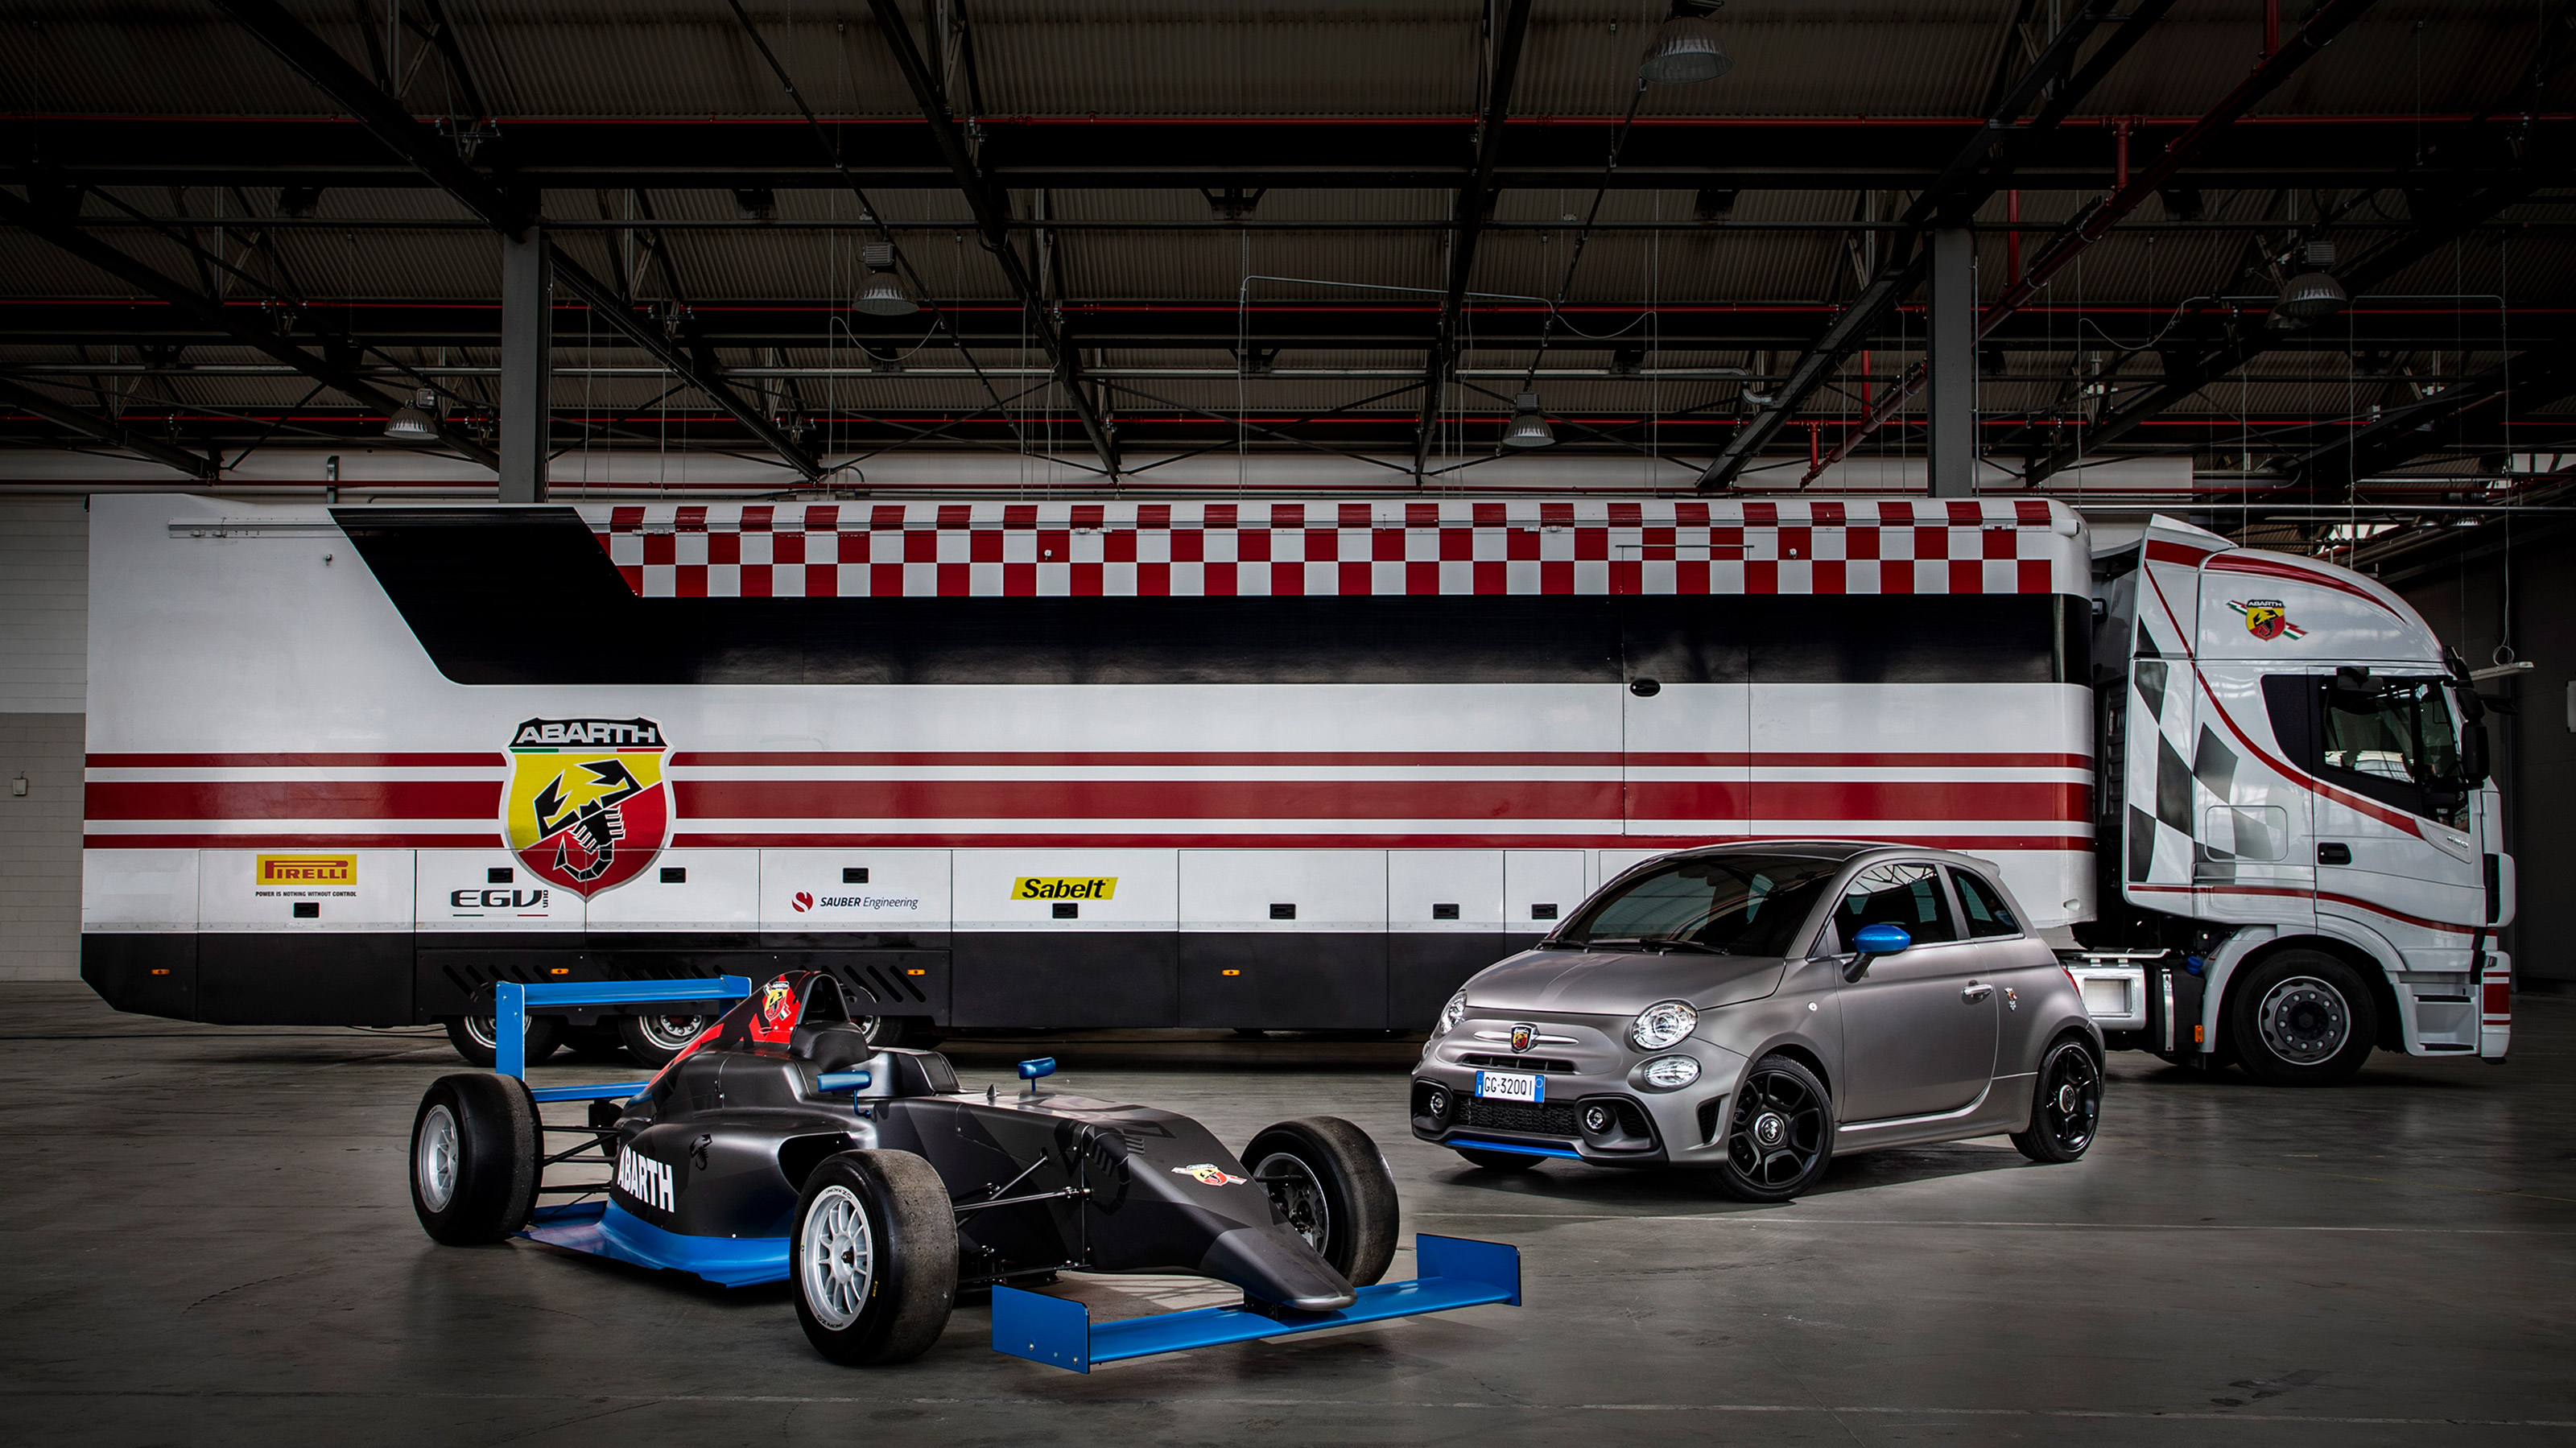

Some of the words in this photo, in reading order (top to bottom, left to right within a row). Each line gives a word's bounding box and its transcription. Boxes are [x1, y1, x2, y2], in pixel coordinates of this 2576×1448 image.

[516, 722, 656, 744] ABARTH
[265, 860, 349, 879] PIRELLI
[451, 889, 543, 907] EGV
[1022, 879, 1106, 898] Sabelt
[820, 897, 861, 907] SAUBER
[863, 897, 919, 910] Engineering
[617, 1144, 675, 1213] ABARTH
